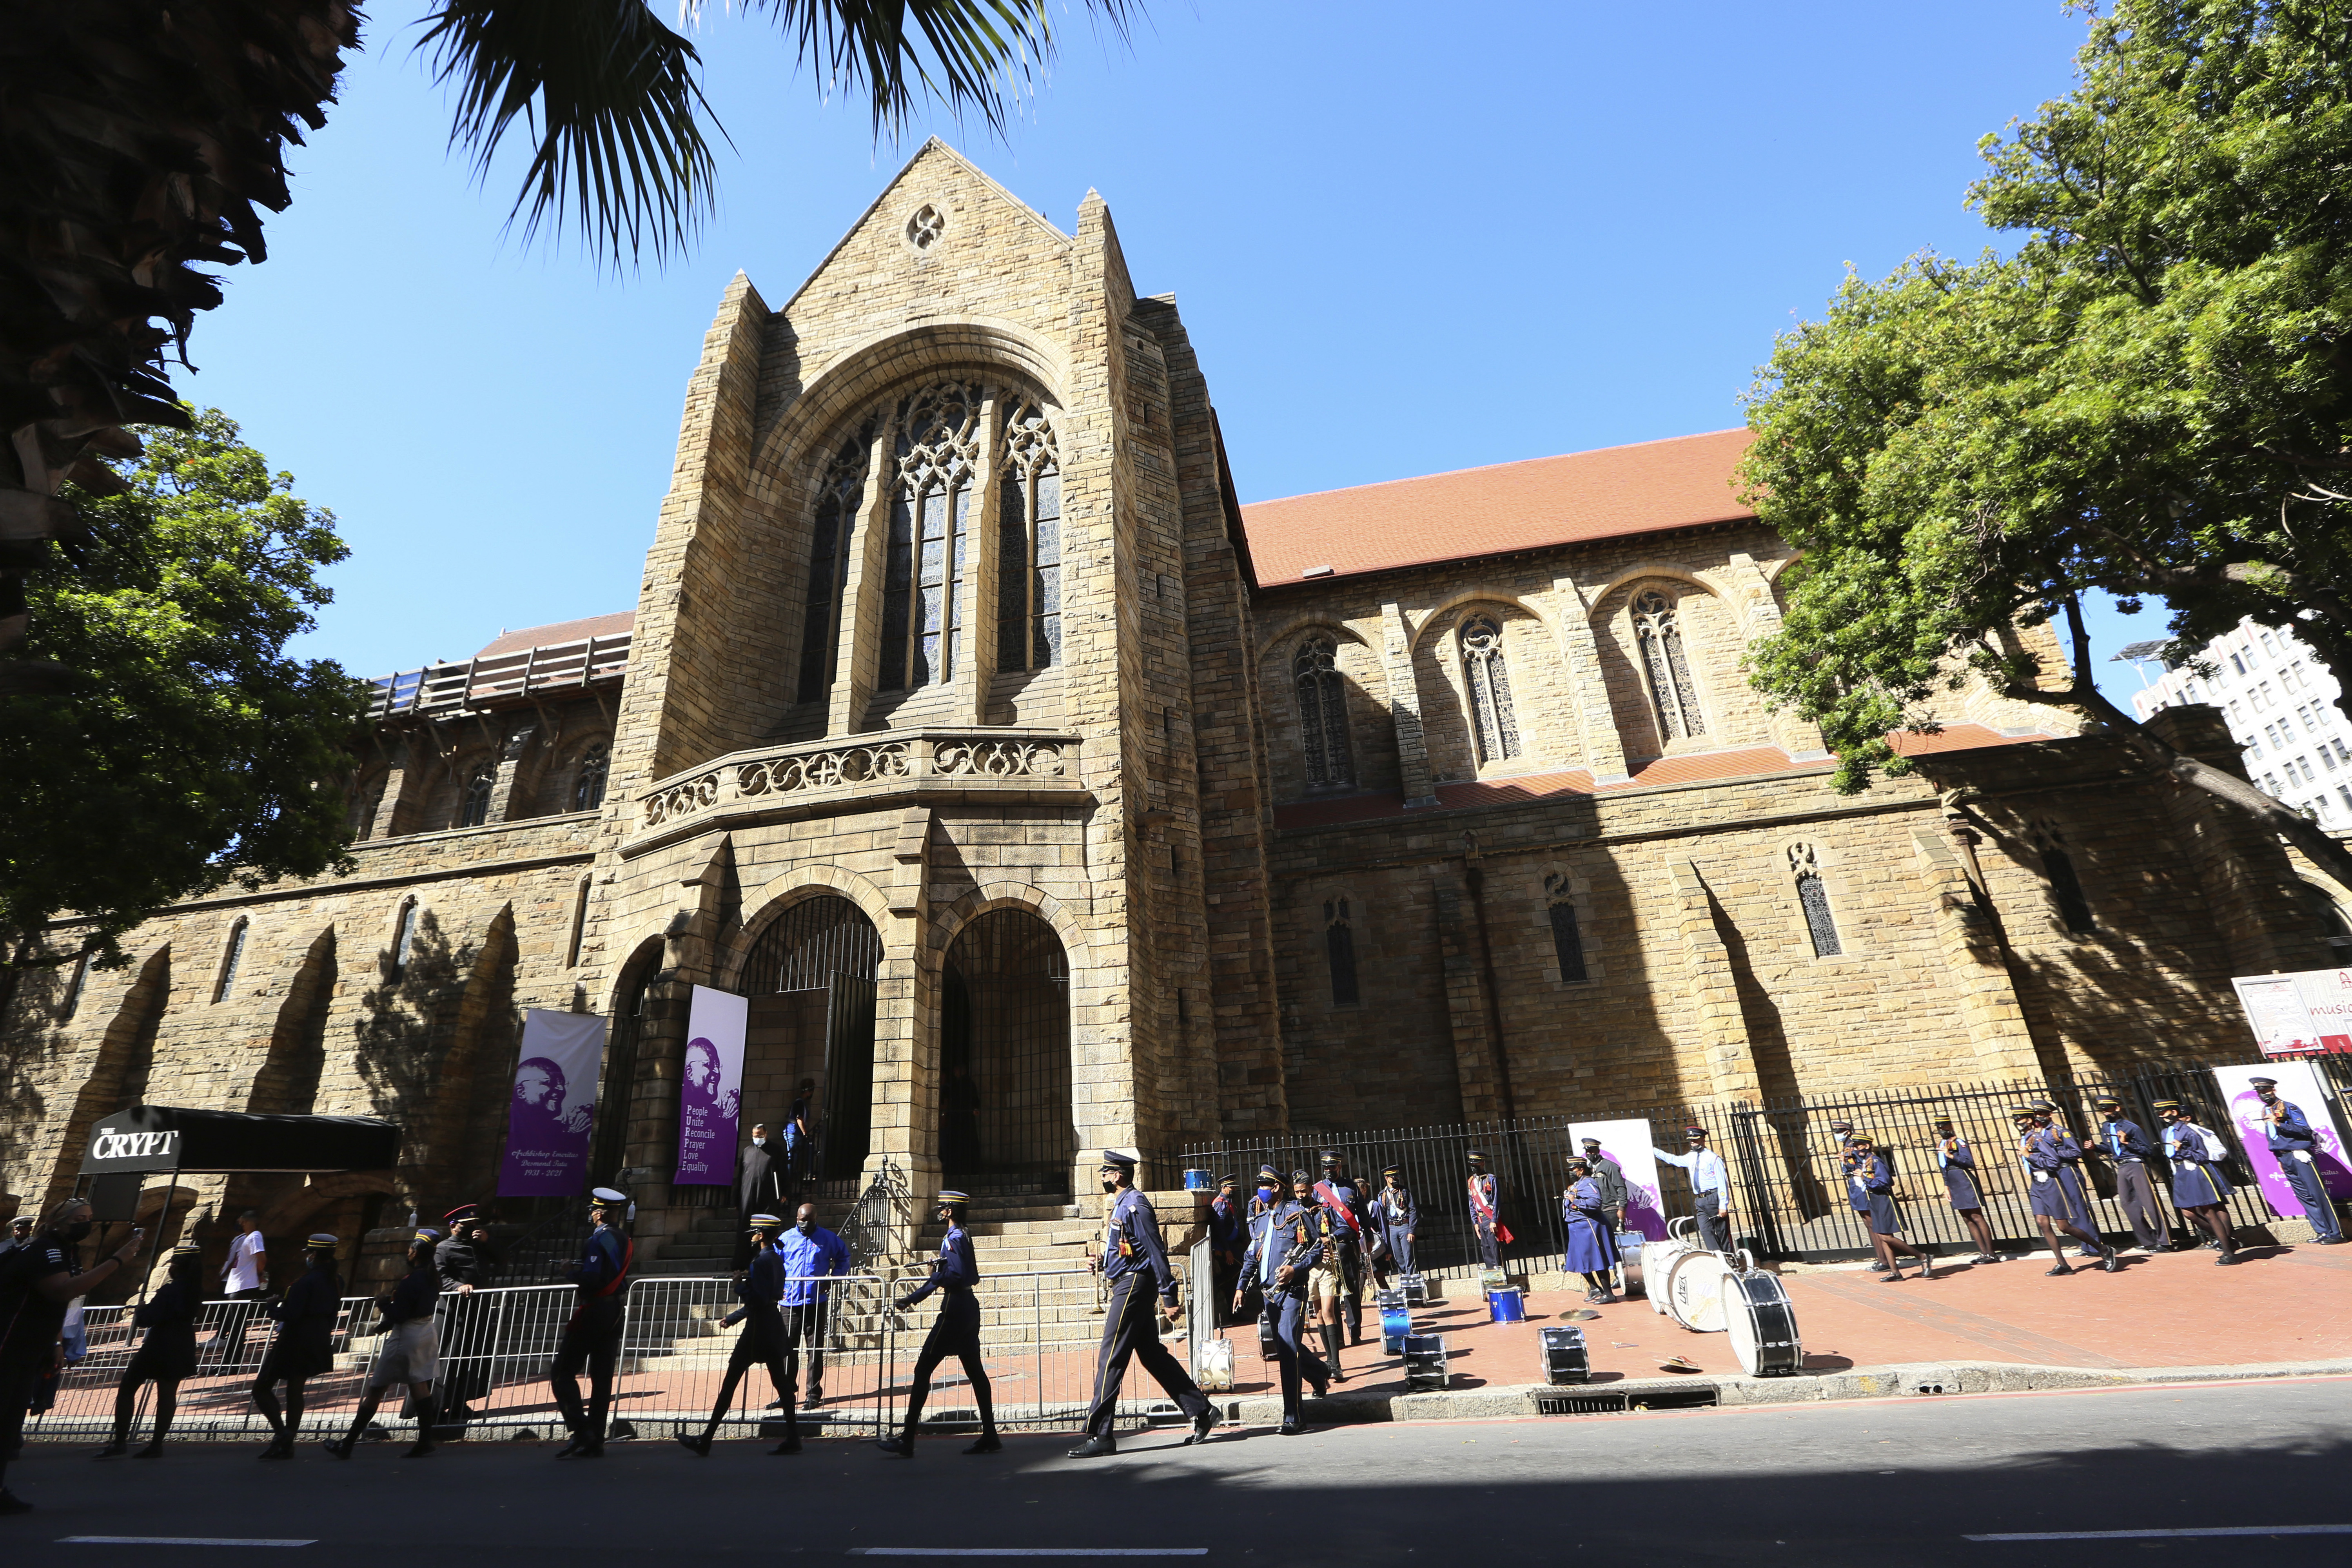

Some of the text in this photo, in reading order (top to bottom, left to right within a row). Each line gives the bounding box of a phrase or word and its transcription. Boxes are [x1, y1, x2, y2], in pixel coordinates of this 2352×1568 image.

[687, 1105, 708, 1118] People
[686, 1116, 704, 1127] Unite
[685, 1127, 715, 1139] Reconcile
[93, 1130, 179, 1159] CRYPT
[684, 1138, 705, 1151] Prayer
[512, 1149, 550, 1159] Archbishop
[683, 1149, 698, 1160] Love
[682, 1161, 708, 1174] Equality
